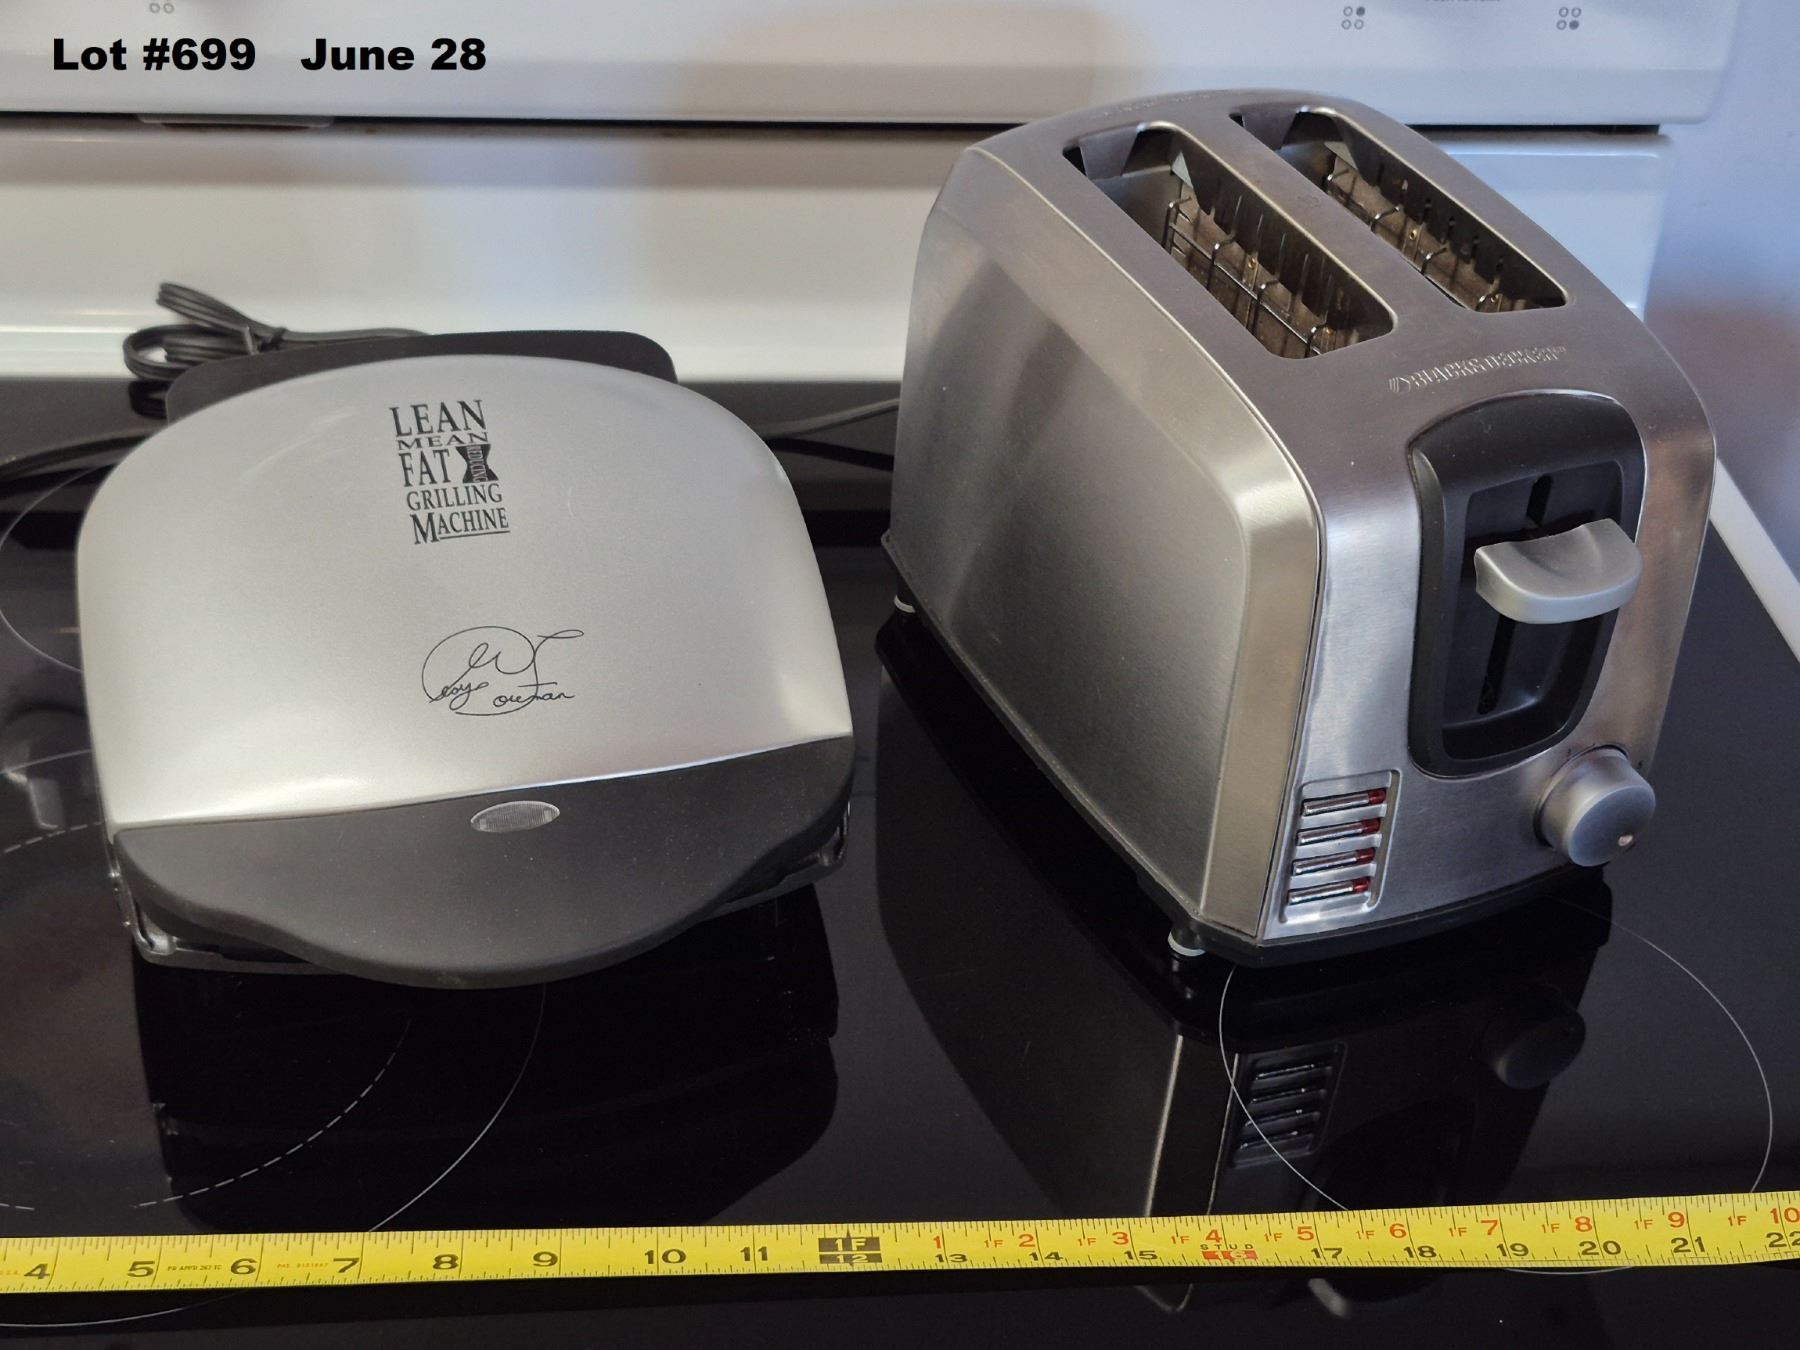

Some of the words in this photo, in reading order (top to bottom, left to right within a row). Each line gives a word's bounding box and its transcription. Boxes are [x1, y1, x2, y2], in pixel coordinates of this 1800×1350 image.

[389, 400, 487, 437] LEAN
[396, 432, 489, 450] MEAN
[399, 448, 451, 487] FAT
[406, 483, 503, 511] GRILLING
[409, 507, 509, 544] MACHINE
[933, 1236, 942, 1249] 1
[1018, 1233, 1036, 1247] 2
[1112, 1232, 1129, 1245] 3
[1205, 1229, 1222, 1243] 4
[1297, 1226, 1315, 1241] 5
[1389, 1223, 1407, 1239] 6
[1480, 1219, 1499, 1236] 7
[1574, 1216, 1593, 1232] 8
[1667, 1211, 1686, 1228] 9
[1770, 1207, 1800, 1224] 10
[24, 1263, 50, 1279] 4
[127, 1261, 155, 1277] 5
[230, 1258, 257, 1275] 6
[333, 1257, 360, 1273] 7
[432, 1254, 459, 1270] 8
[532, 1251, 559, 1267] 9
[644, 1249, 687, 1264] 10
[740, 1246, 768, 1262] 11
[836, 1254, 869, 1264] 12
[935, 1253, 968, 1263] 13
[1029, 1251, 1063, 1262] 14
[1124, 1250, 1158, 1260] 15
[1311, 1247, 1343, 1259] 17
[1403, 1246, 1437, 1258] 18
[1496, 1243, 1529, 1257] 19
[1579, 1240, 1621, 1256] 20
[1671, 1236, 1706, 1253] 21
